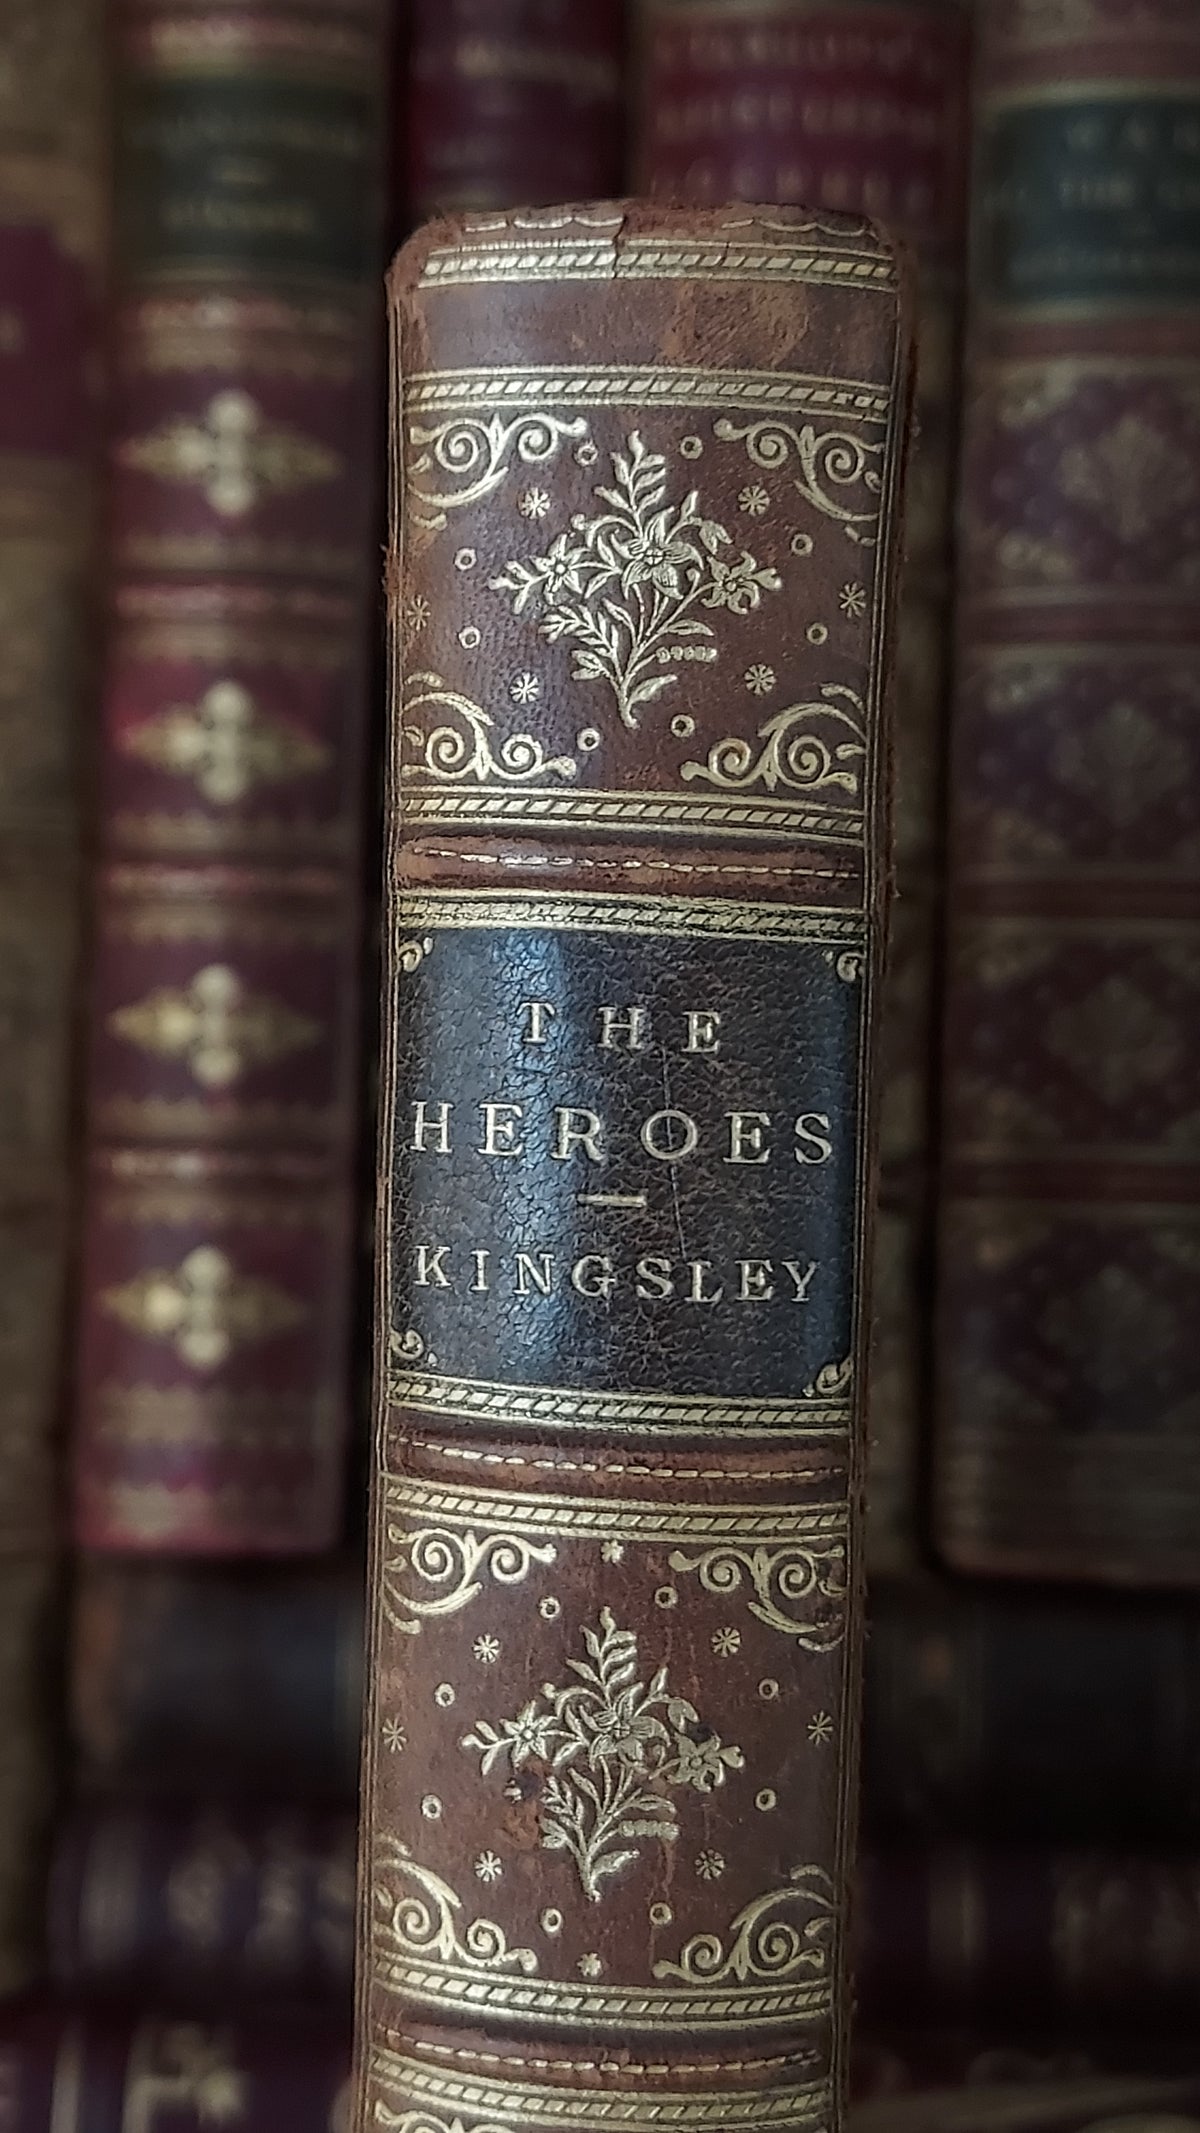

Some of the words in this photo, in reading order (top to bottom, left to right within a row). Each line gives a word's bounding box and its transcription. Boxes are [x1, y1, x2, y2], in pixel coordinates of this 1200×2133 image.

[520, 1001, 721, 1054] THE
[410, 1101, 833, 1164] HEROES
[413, 1245, 818, 1302] KINGSLEY
